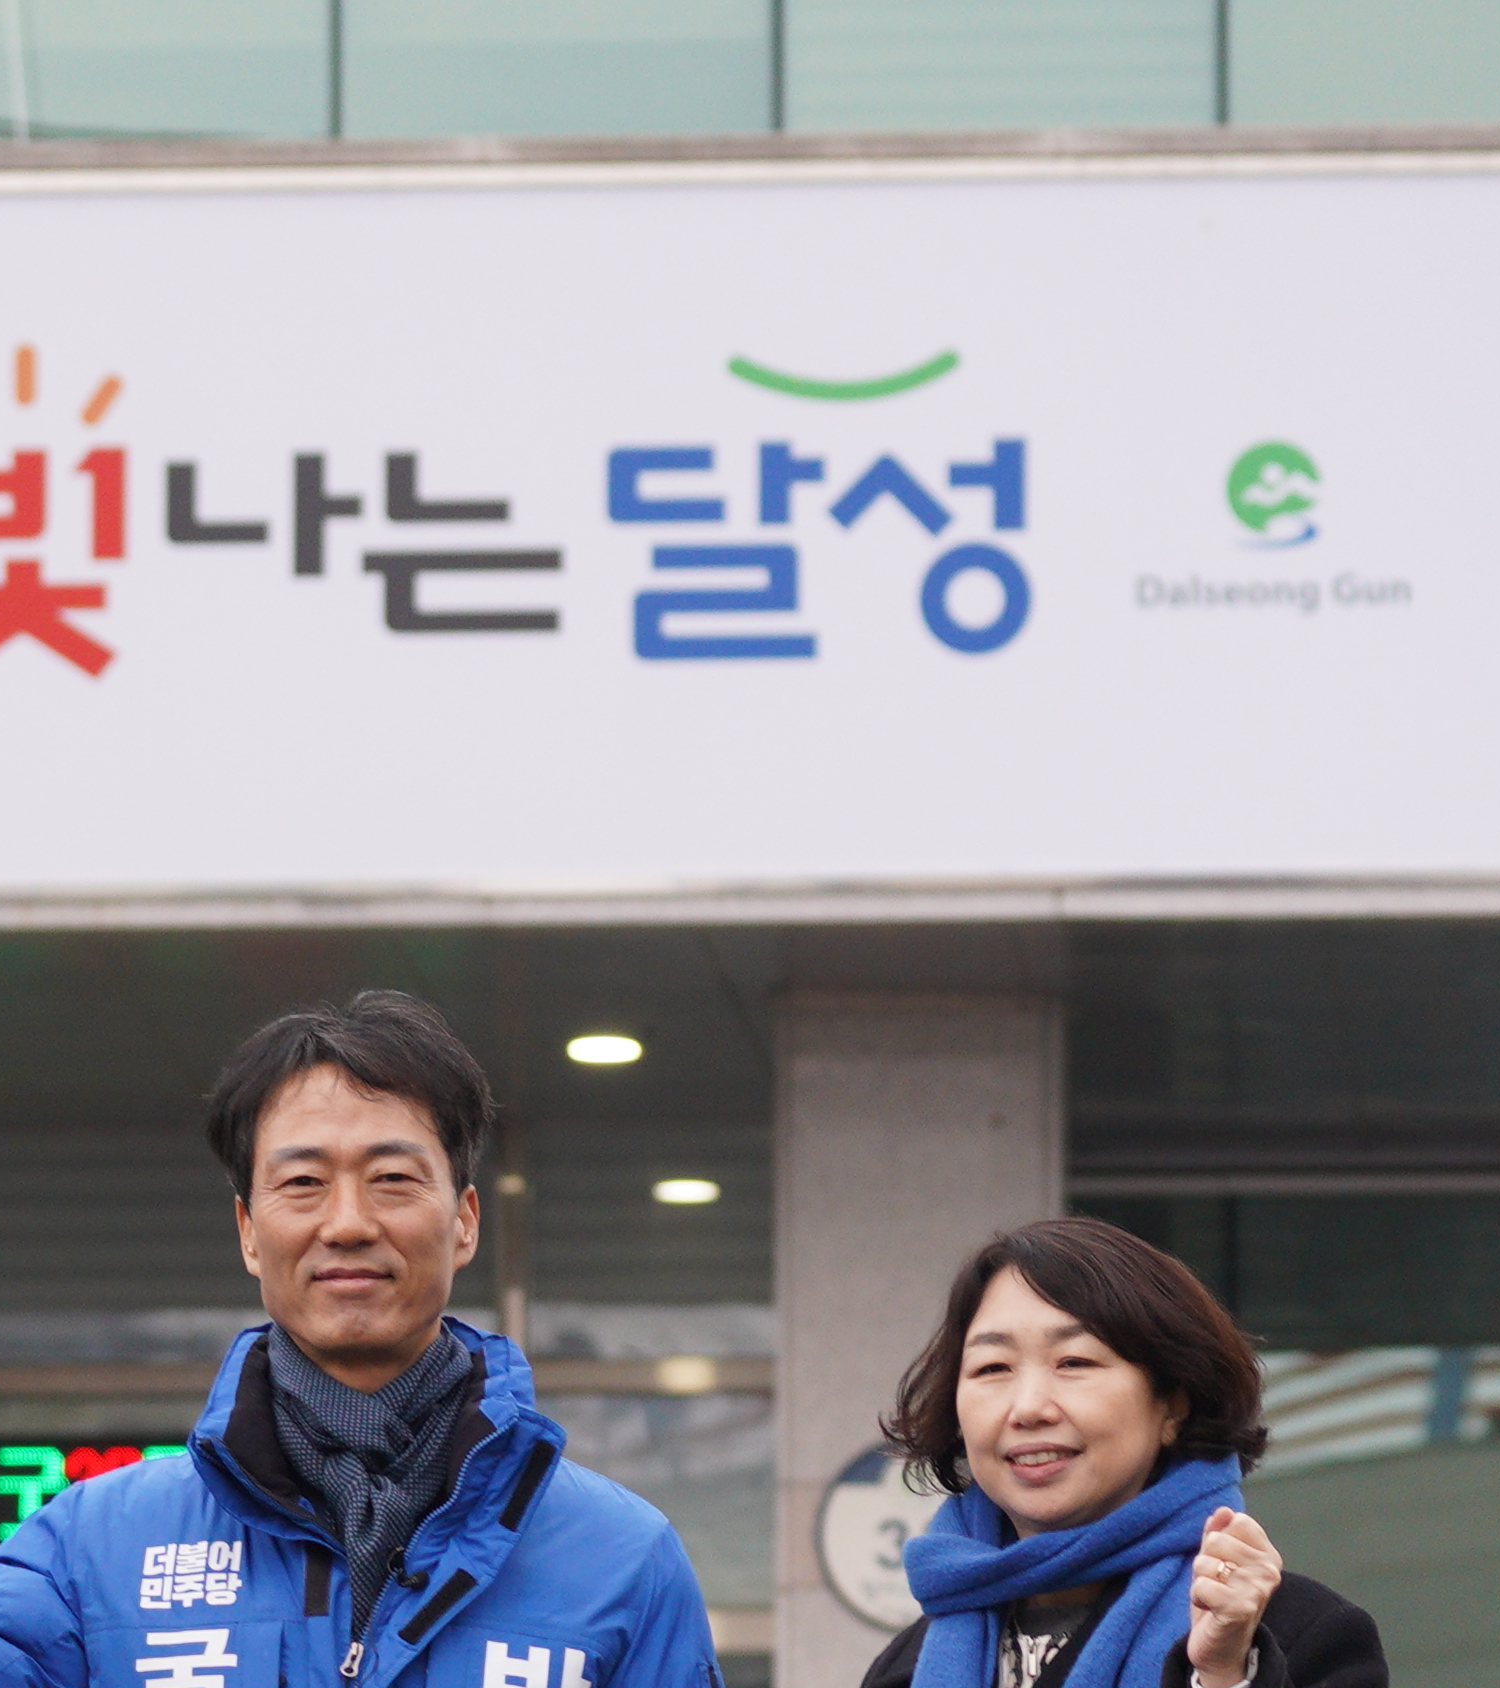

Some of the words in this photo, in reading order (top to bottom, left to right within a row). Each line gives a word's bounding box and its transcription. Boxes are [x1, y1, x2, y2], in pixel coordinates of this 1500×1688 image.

[605, 438, 1032, 662] 달성
[1135, 573, 1323, 617] Dalseong
[1331, 571, 1414, 606] Gun
[142, 1540, 243, 1575] 더불어
[139, 1572, 243, 1609] 민주당
